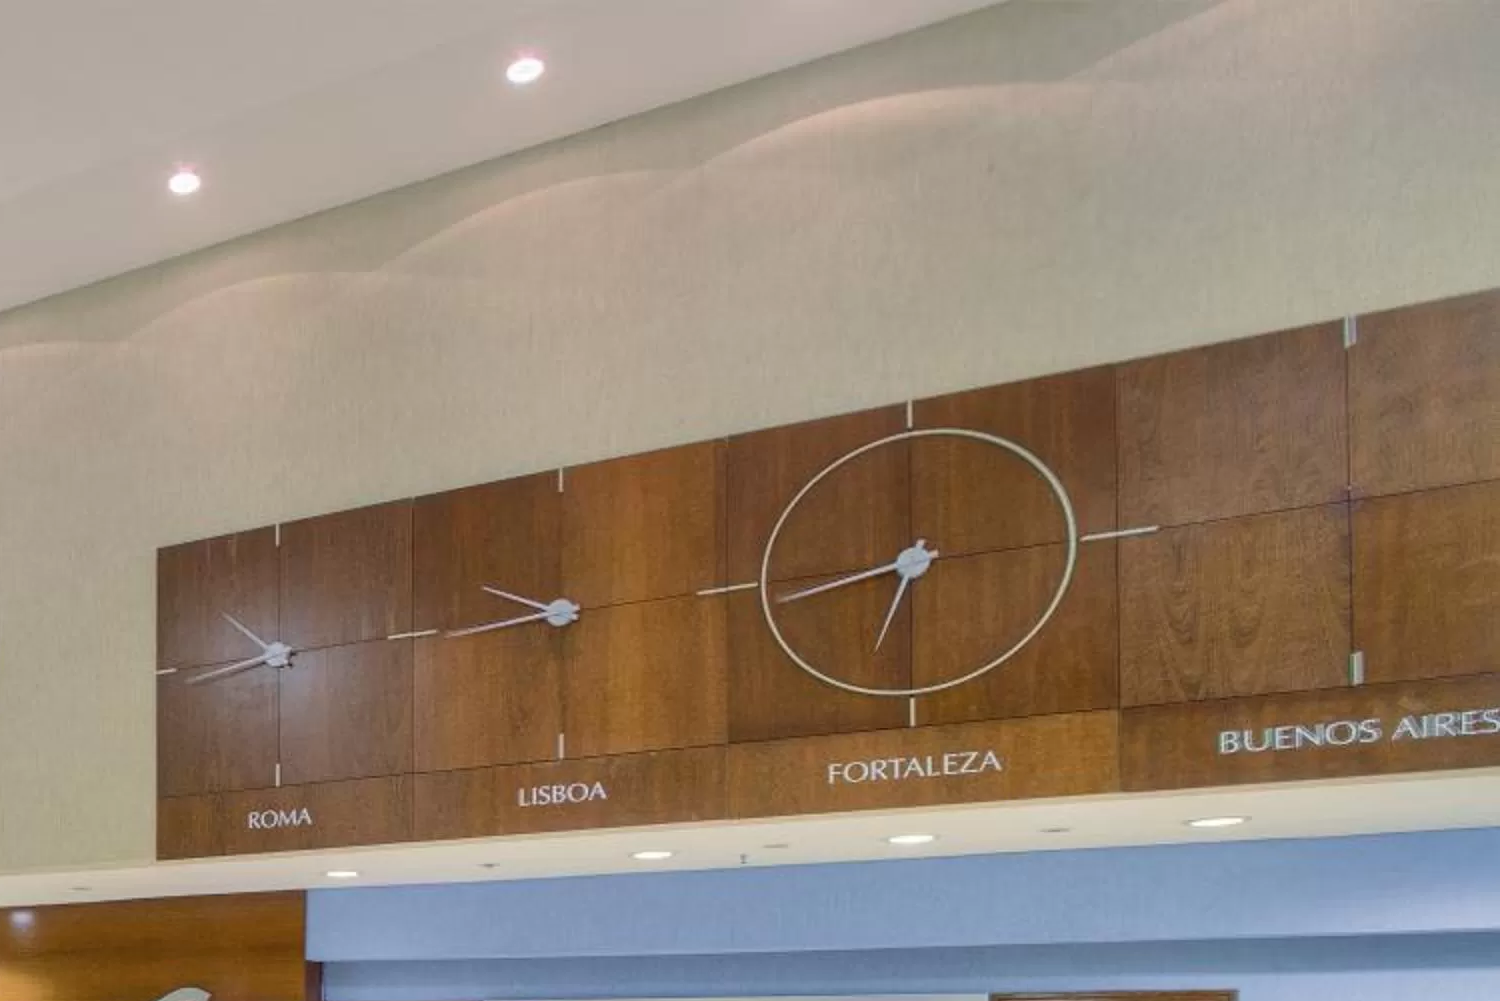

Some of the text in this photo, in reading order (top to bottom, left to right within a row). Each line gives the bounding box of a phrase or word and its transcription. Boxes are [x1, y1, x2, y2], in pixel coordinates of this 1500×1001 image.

[1219, 707, 1500, 755] BUENOS AIRES
[827, 750, 1003, 785] FORTALEZA
[517, 781, 608, 807] LISBOA
[247, 807, 313, 829] ROMA
